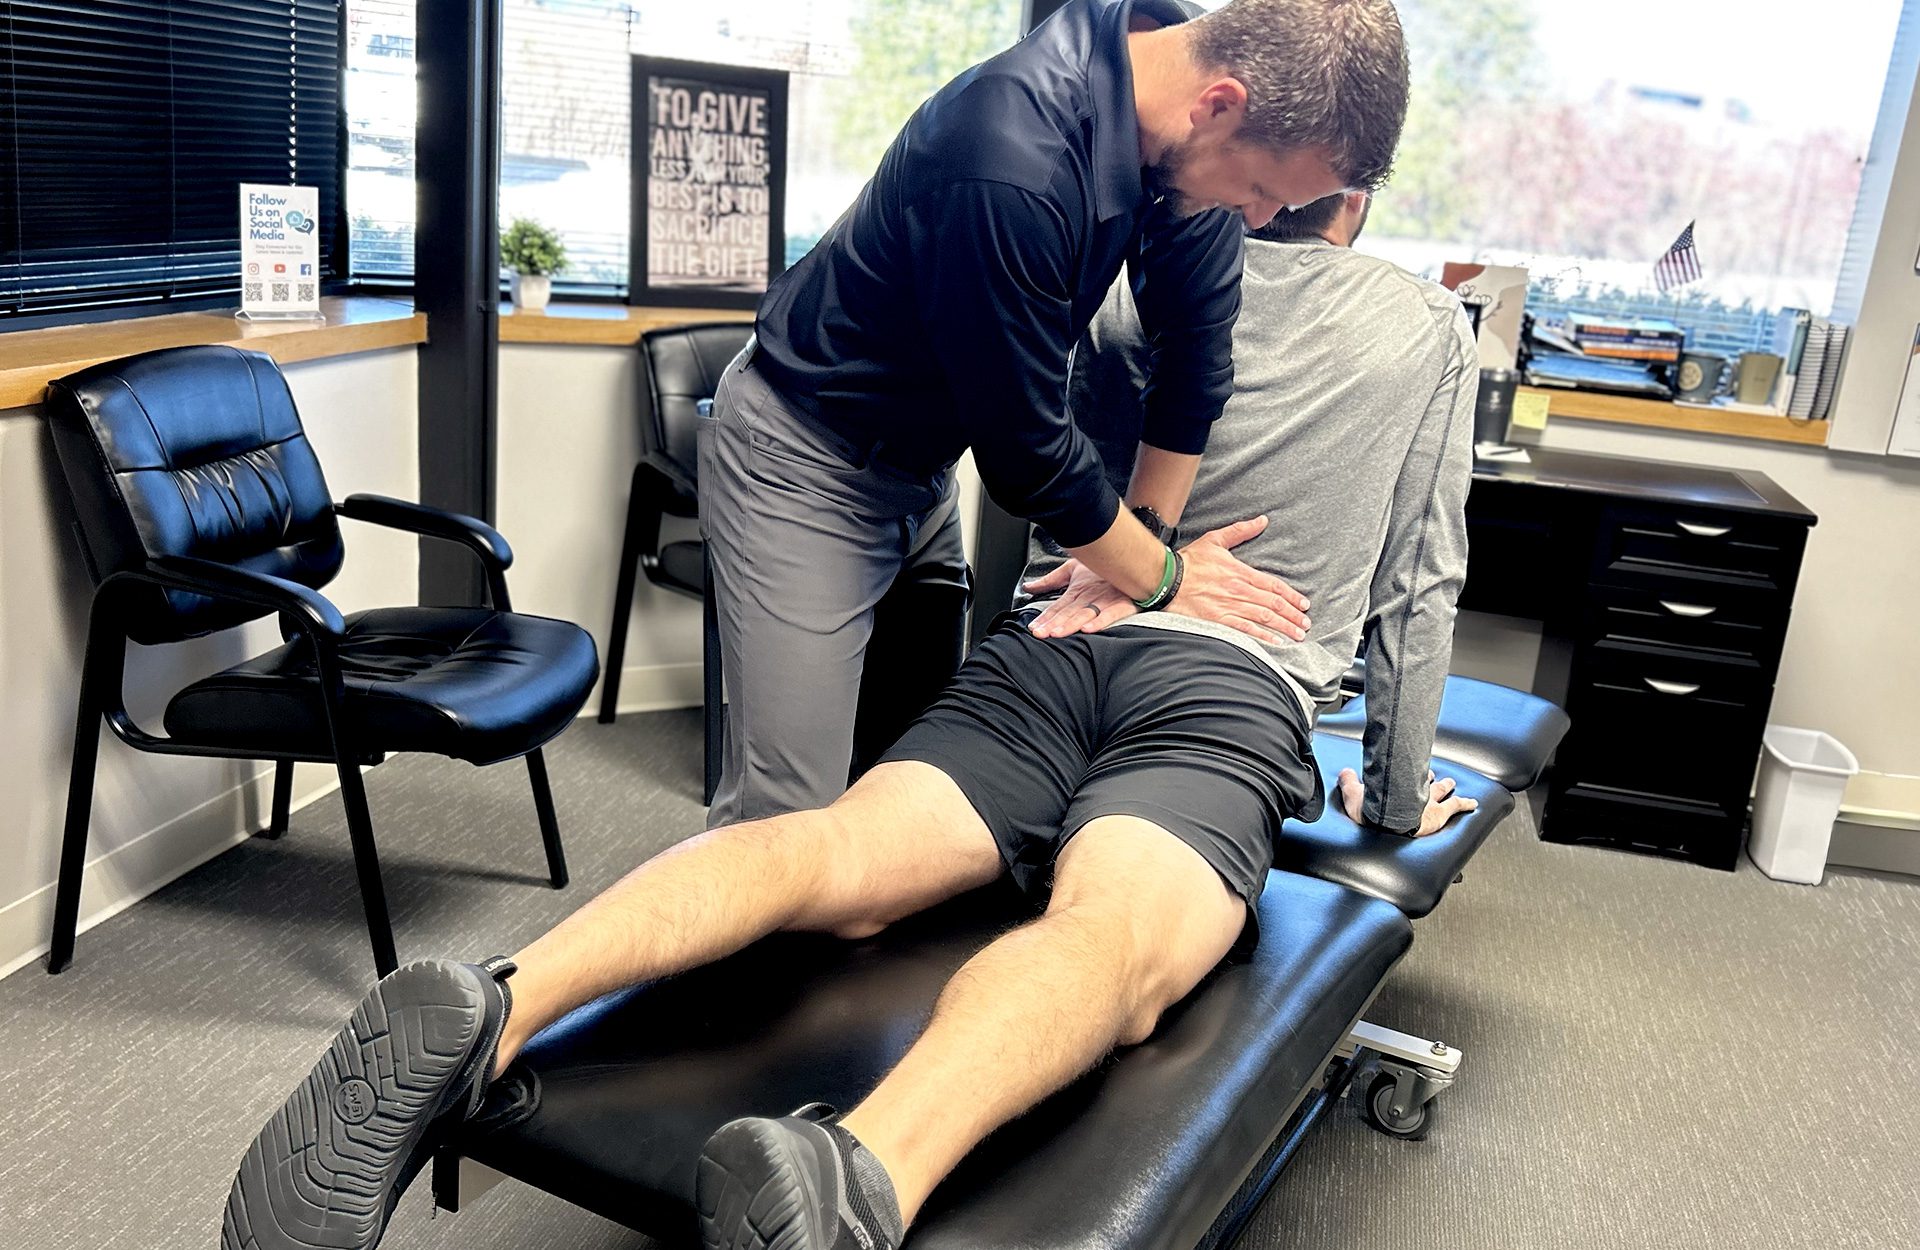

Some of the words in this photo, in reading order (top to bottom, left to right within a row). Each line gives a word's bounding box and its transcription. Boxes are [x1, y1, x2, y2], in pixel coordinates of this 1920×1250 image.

[654, 85, 691, 129] TO
[698, 90, 768, 136] GIVE
[652, 127, 767, 167] ANYHING
[651, 158, 687, 180] LESS
[728, 164, 767, 186] YOUR
[249, 193, 287, 206] Follow
[249, 205, 263, 217] Us
[265, 209, 280, 217] on
[711, 184, 733, 215] IS
[737, 186, 764, 216] TO
[250, 217, 283, 229] Social
[250, 229, 285, 240] Media
[652, 213, 764, 247] SACRIFICE
[652, 242, 701, 275] THE
[704, 245, 763, 279] GIFT.
